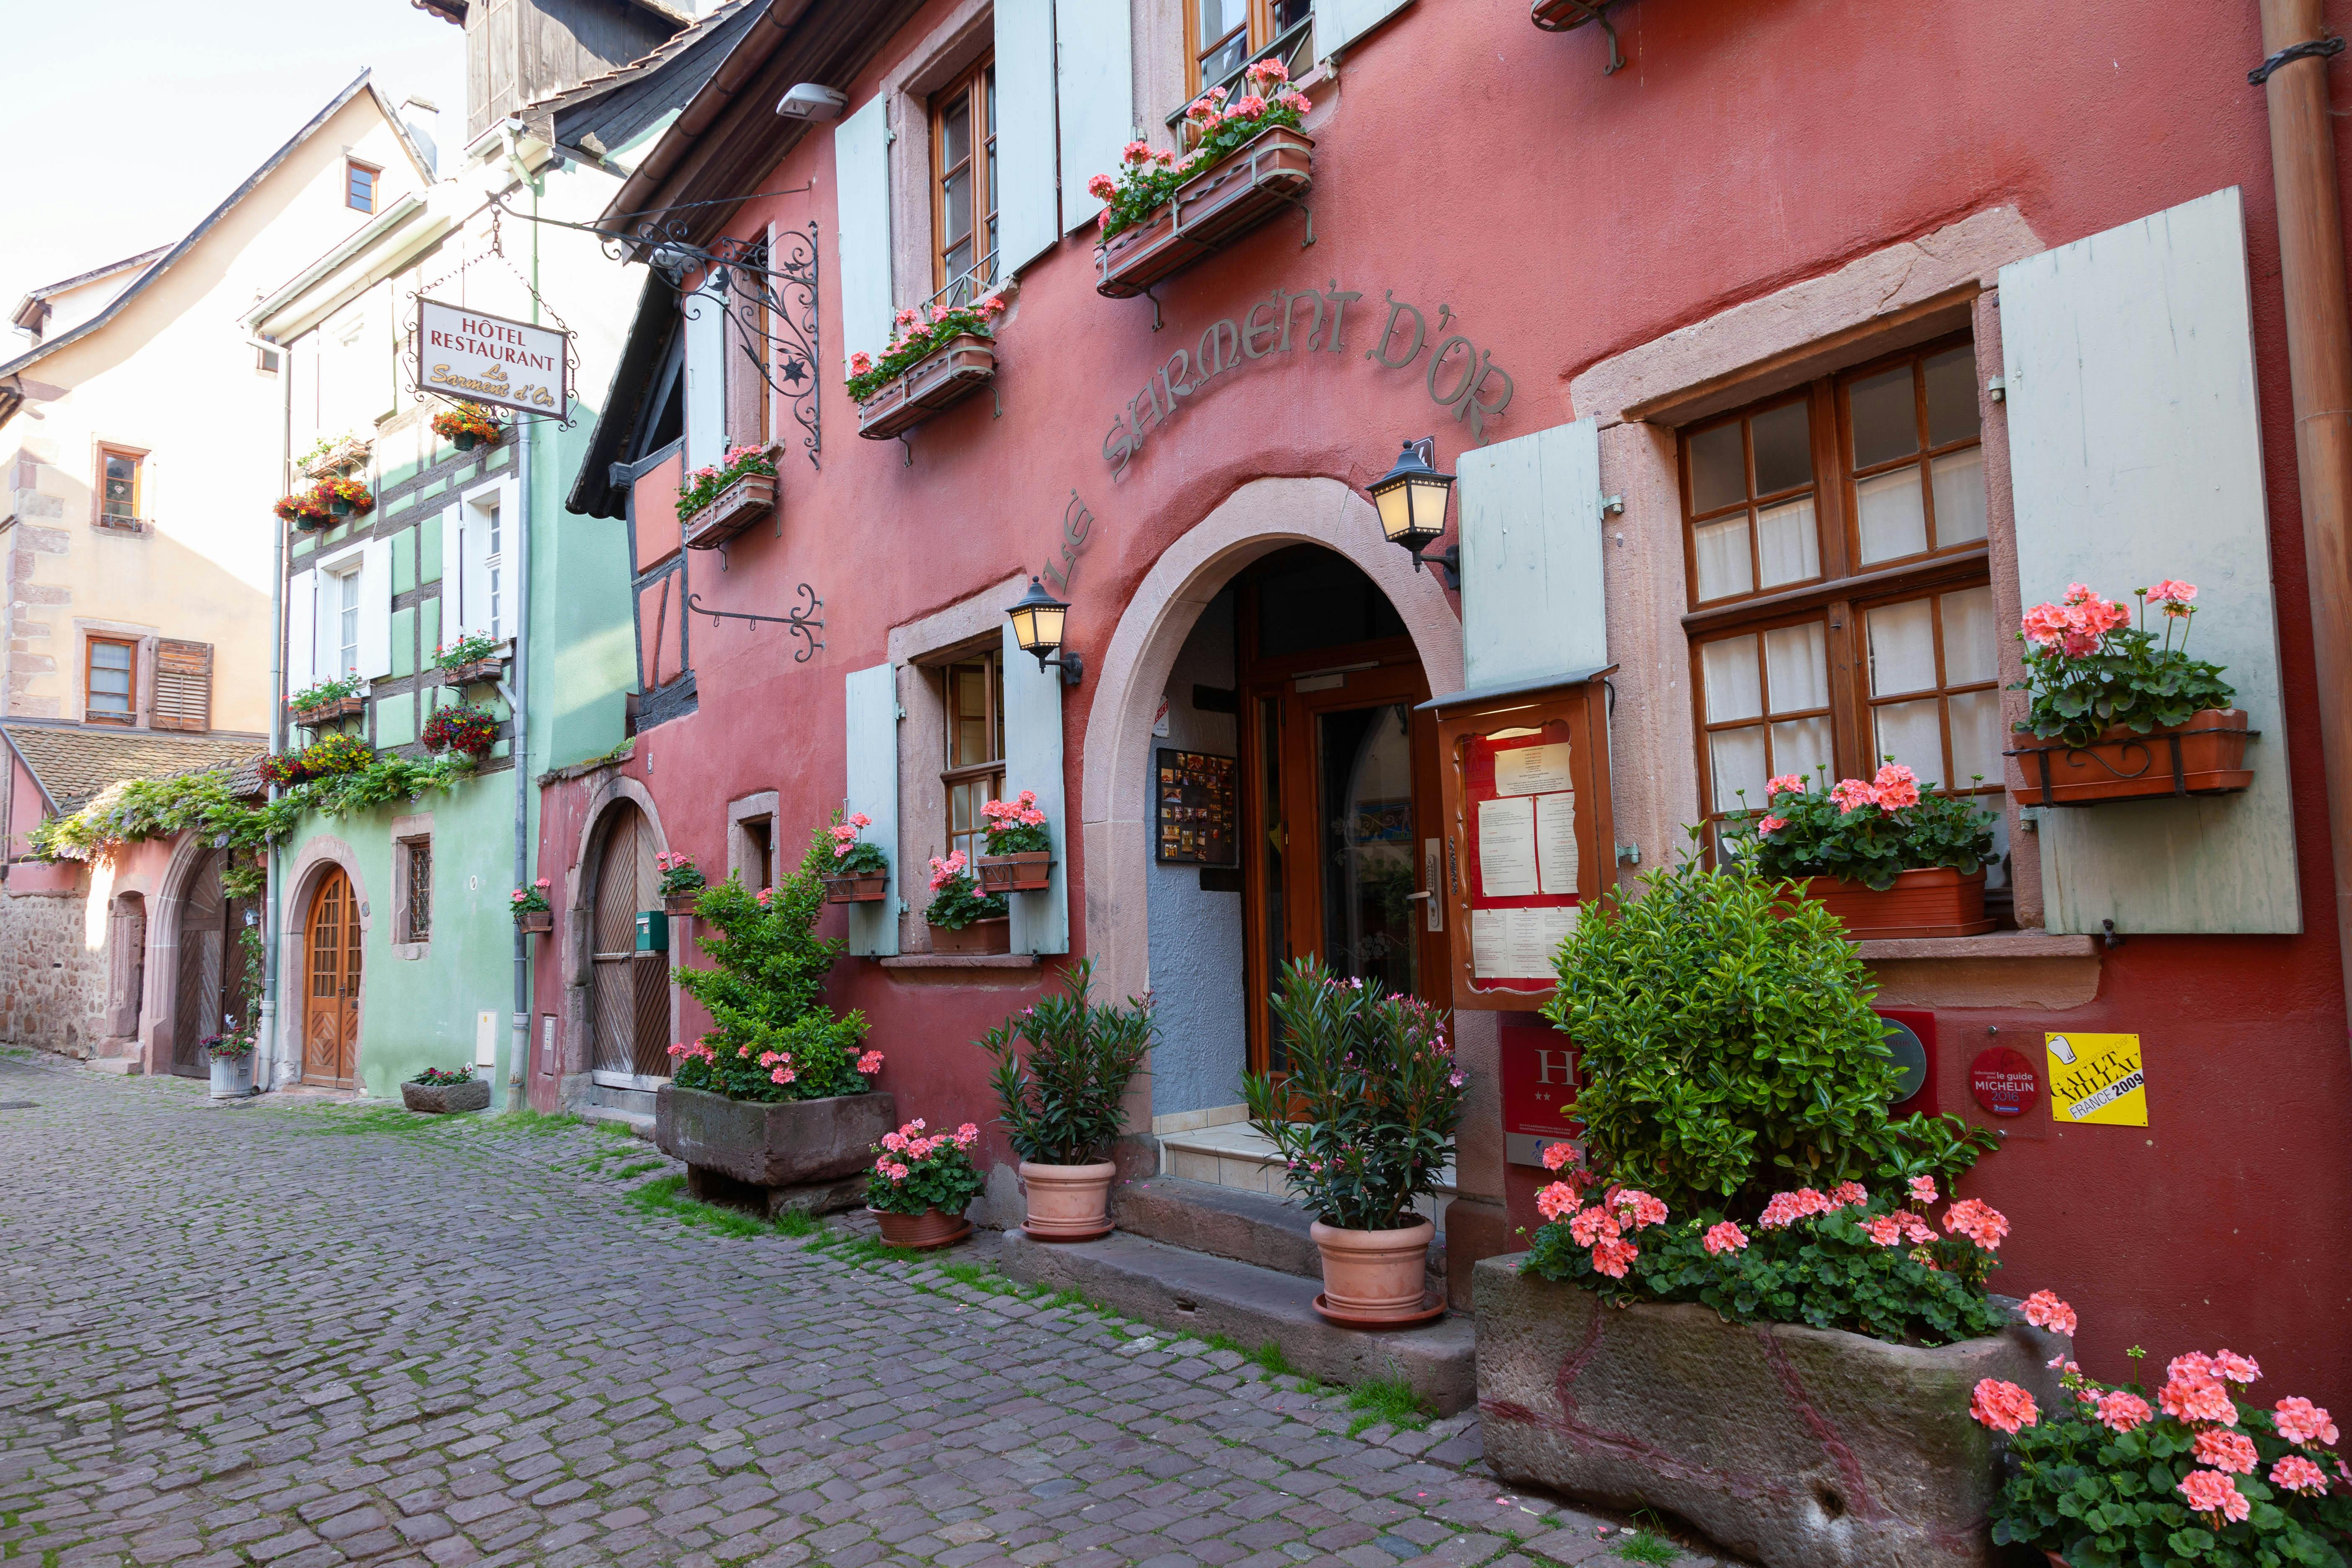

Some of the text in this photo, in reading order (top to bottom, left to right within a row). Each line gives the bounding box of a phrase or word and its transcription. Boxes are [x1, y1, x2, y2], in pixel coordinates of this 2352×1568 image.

[431, 330, 554, 371] RESTAURANT
[462, 318, 526, 346] HÔTEL
[430, 364, 554, 407] Sarment d'Or
[481, 364, 508, 381] Le
[1103, 279, 1363, 483] SARMENT
[1534, 1050, 1579, 1086] H
[2007, 1073, 2033, 1081] guide
[2050, 1051, 2117, 1097] GAULT
[2053, 1037, 2128, 1081] Recommandé par
[2059, 1052, 2142, 1105] MILLAU
[1975, 1081, 2034, 1092] MICHELIN
[1991, 1091, 2019, 1101] 2016
[2069, 1073, 2144, 1119] FRANCE 2009
